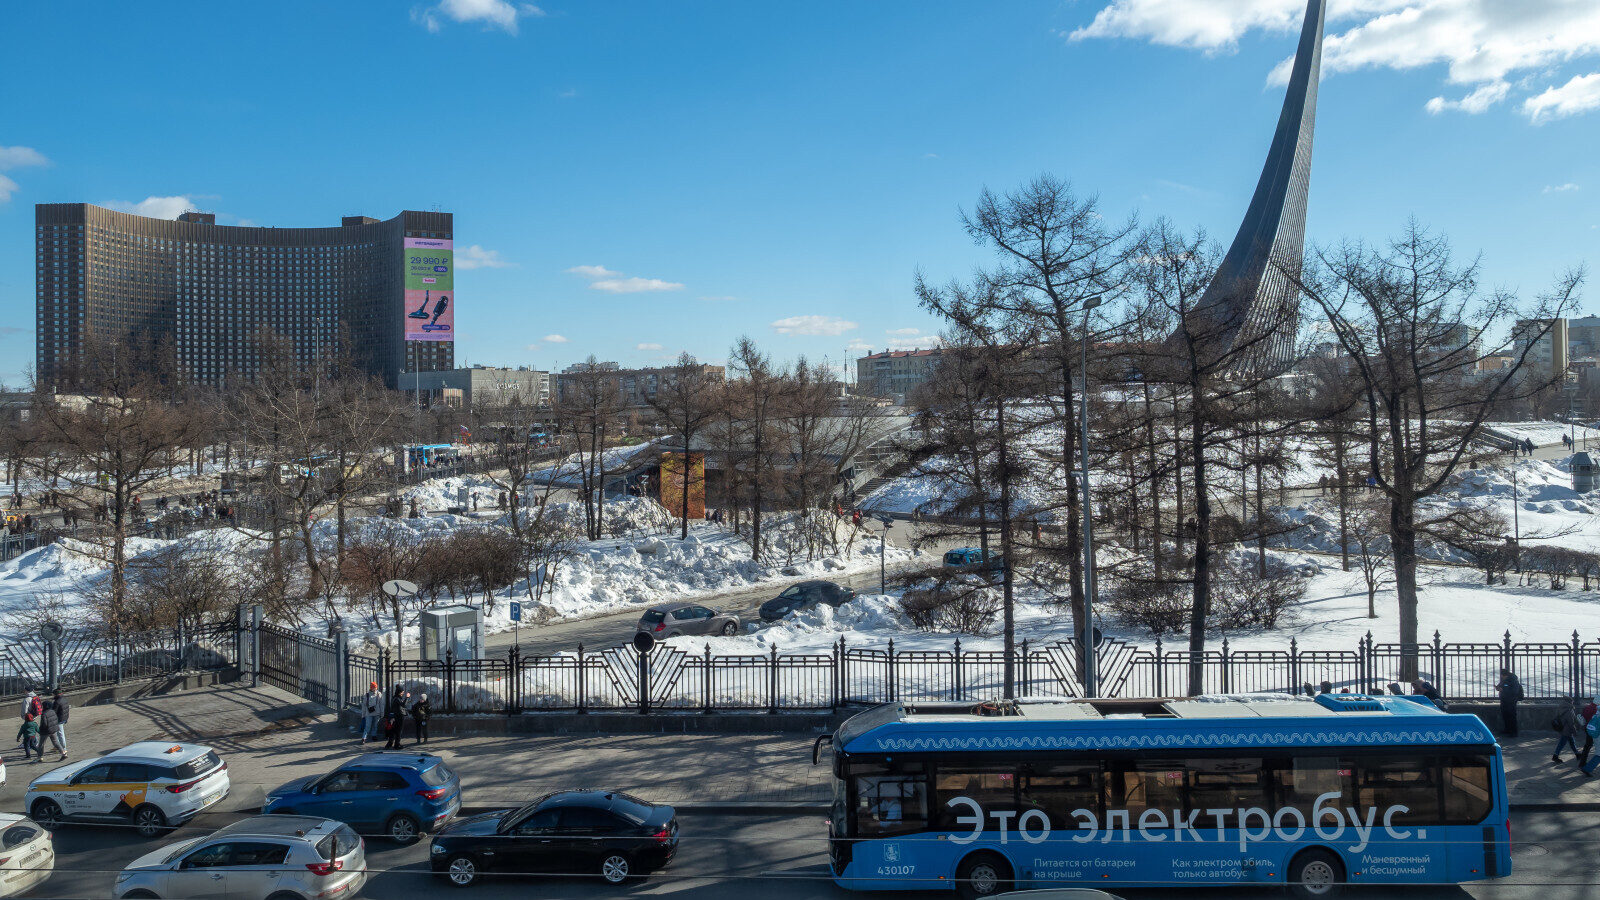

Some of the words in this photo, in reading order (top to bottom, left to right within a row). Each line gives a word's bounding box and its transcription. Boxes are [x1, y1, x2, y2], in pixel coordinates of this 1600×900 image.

[410, 256, 422, 264] 29
[423, 257, 440, 265] 990
[512, 604, 519, 619] P
[947, 796, 1051, 844] Это
[1070, 791, 1427, 854] электробус.
[1034, 858, 1080, 868] Питается
[1081, 860, 1093, 868] от
[1094, 857, 1136, 869] батареи
[1172, 858, 1191, 868] Как
[1361, 854, 1431, 865] Маневренный
[877, 865, 915, 875] 430107
[1047, 870, 1082, 879] крыше
[1173, 870, 1207, 878] только
[1208, 868, 1248, 879] автобус
[1369, 865, 1426, 877] бесшумный
